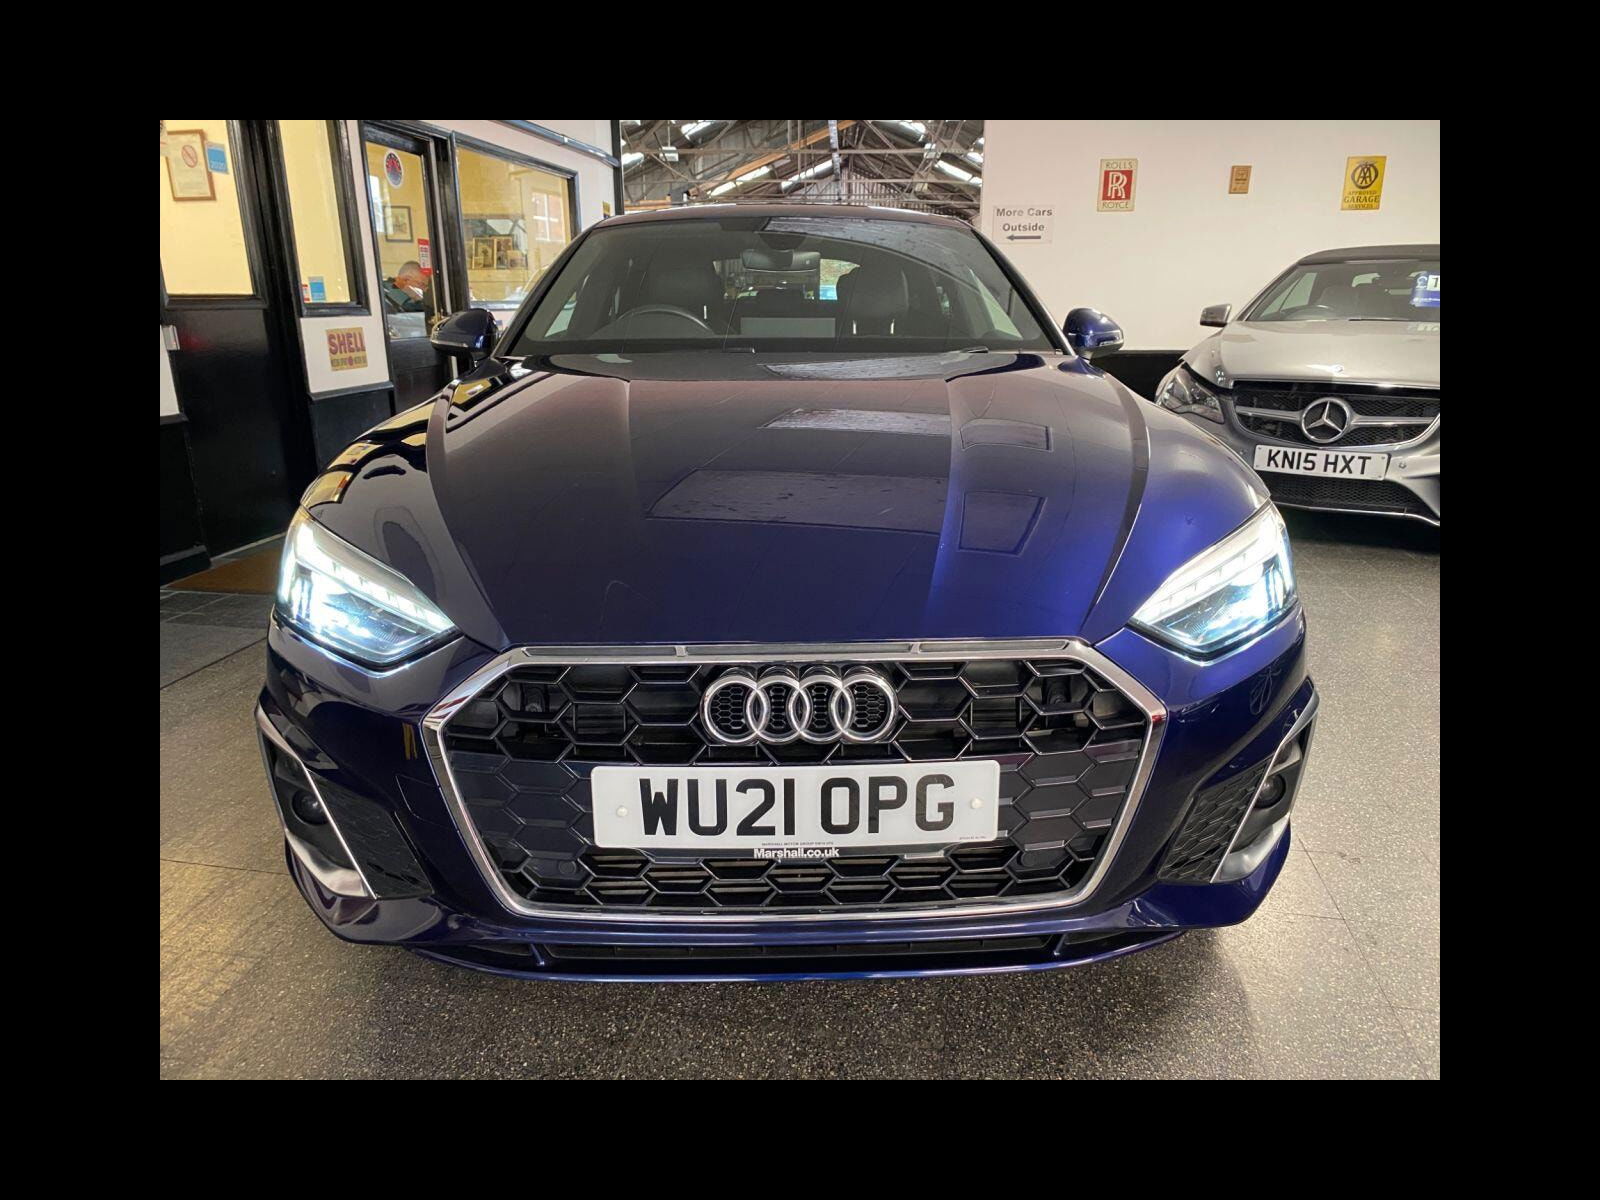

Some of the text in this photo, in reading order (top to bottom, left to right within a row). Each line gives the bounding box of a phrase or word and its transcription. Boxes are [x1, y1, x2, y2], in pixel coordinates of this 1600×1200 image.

[1105, 161, 1134, 169] ROLLS
[1344, 195, 1380, 203] GARAGE
[1102, 201, 1129, 209] ROYCE
[996, 207, 1053, 217] More Cars
[1002, 222, 1045, 232] Outside
[328, 332, 366, 355] SHELL
[1266, 449, 1372, 475] KN15 HXT
[638, 773, 956, 837] WU21 OPG
[753, 847, 840, 859] Marshall.co.uk
